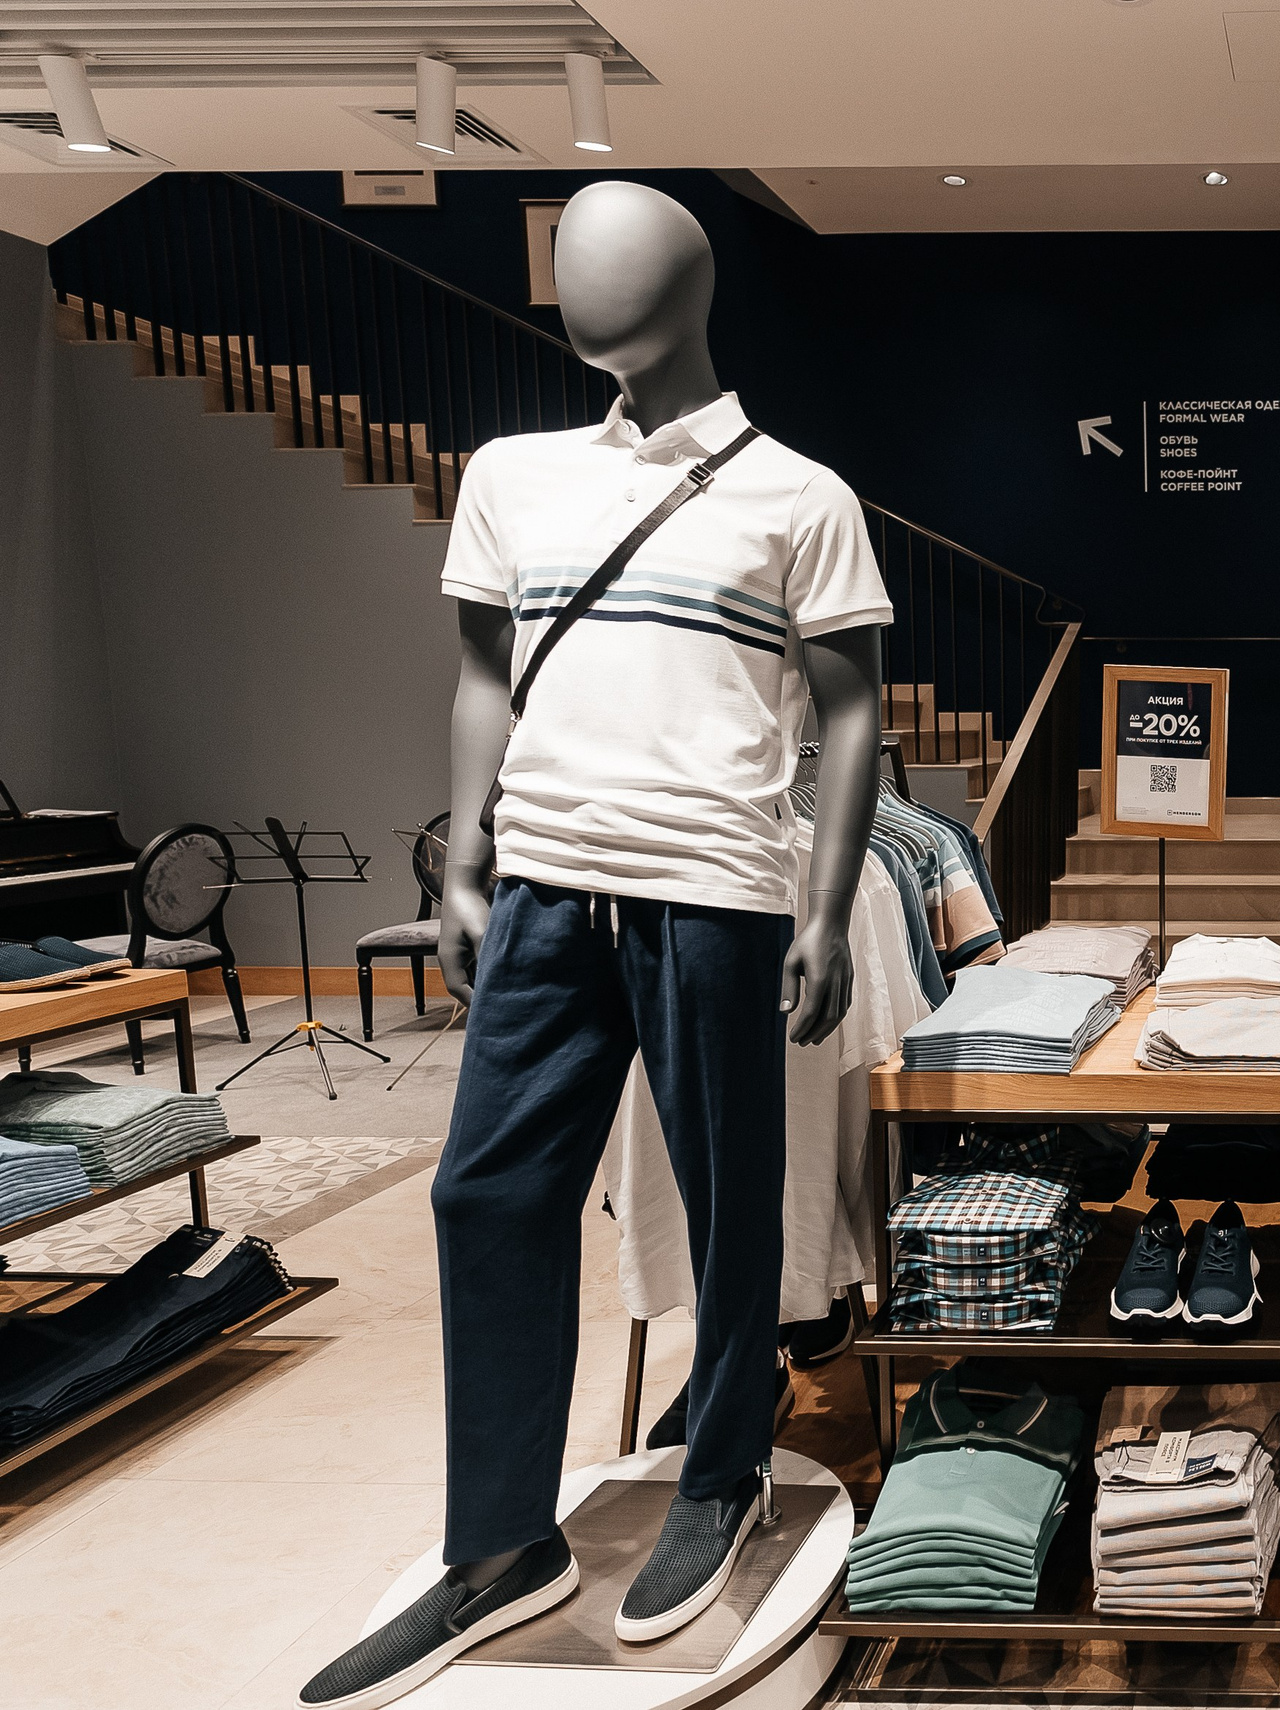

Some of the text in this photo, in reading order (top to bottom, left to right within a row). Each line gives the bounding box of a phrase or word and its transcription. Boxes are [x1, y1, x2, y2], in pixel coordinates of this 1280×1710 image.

[1159, 400, 1252, 410] КЛАССИЧЕСКАЯ
[1159, 413, 1245, 423] FORMAL WEAR
[1160, 435, 1198, 445] ОБУВЬ
[1160, 448, 1198, 457] SHOES
[1160, 467, 1238, 479] КОФЕ-ПОЙНТ
[1160, 481, 1242, 492] COFFEE POINT
[1147, 695, 1184, 706] АКЦИЯ
[1129, 713, 1201, 737] -20%
